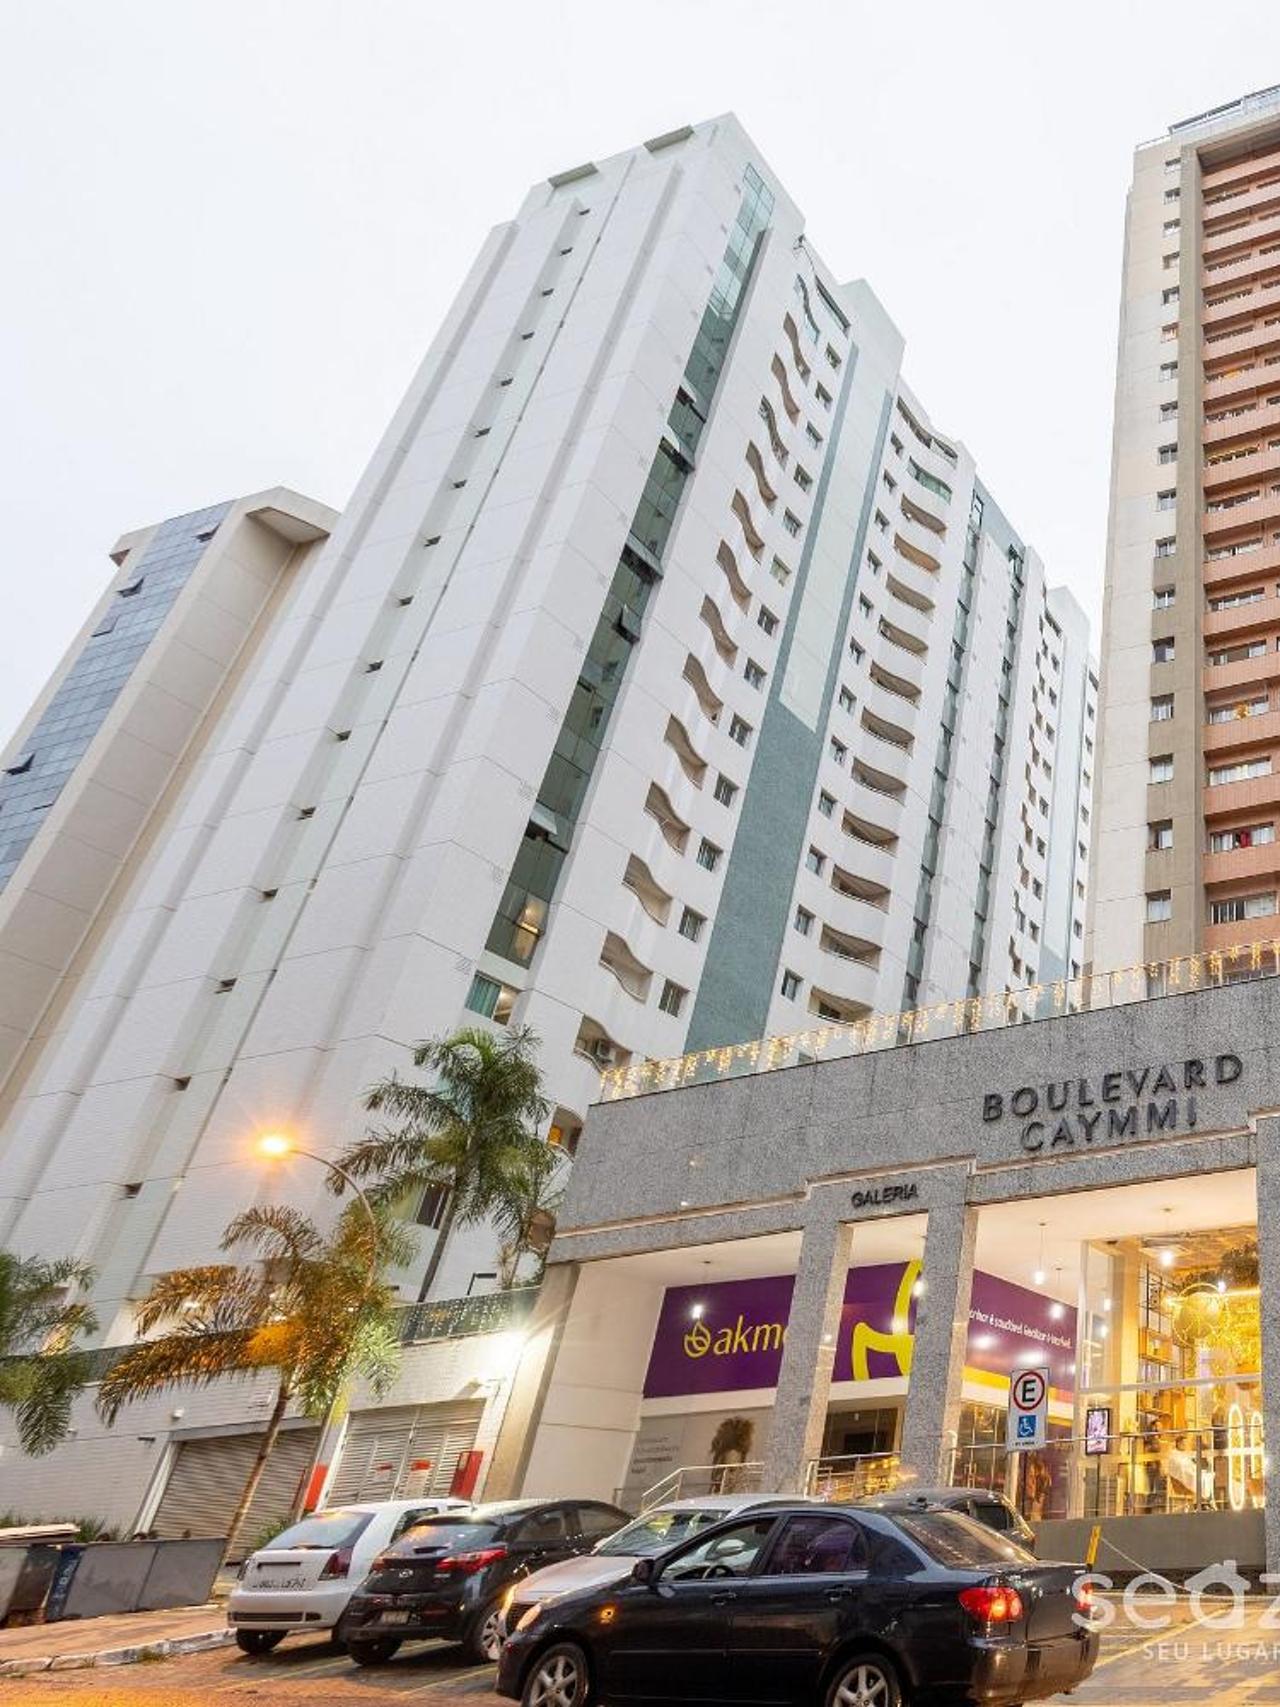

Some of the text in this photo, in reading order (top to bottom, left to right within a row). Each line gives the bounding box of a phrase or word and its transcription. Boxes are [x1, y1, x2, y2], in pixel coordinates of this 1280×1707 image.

[983, 1054, 1243, 1122] BOULEVARD
[1020, 1096, 1197, 1151] CAYMMI
[851, 1183, 919, 1209] GALERIA
[713, 1315, 789, 1355] akm
[1022, 1379, 1037, 1403] E
